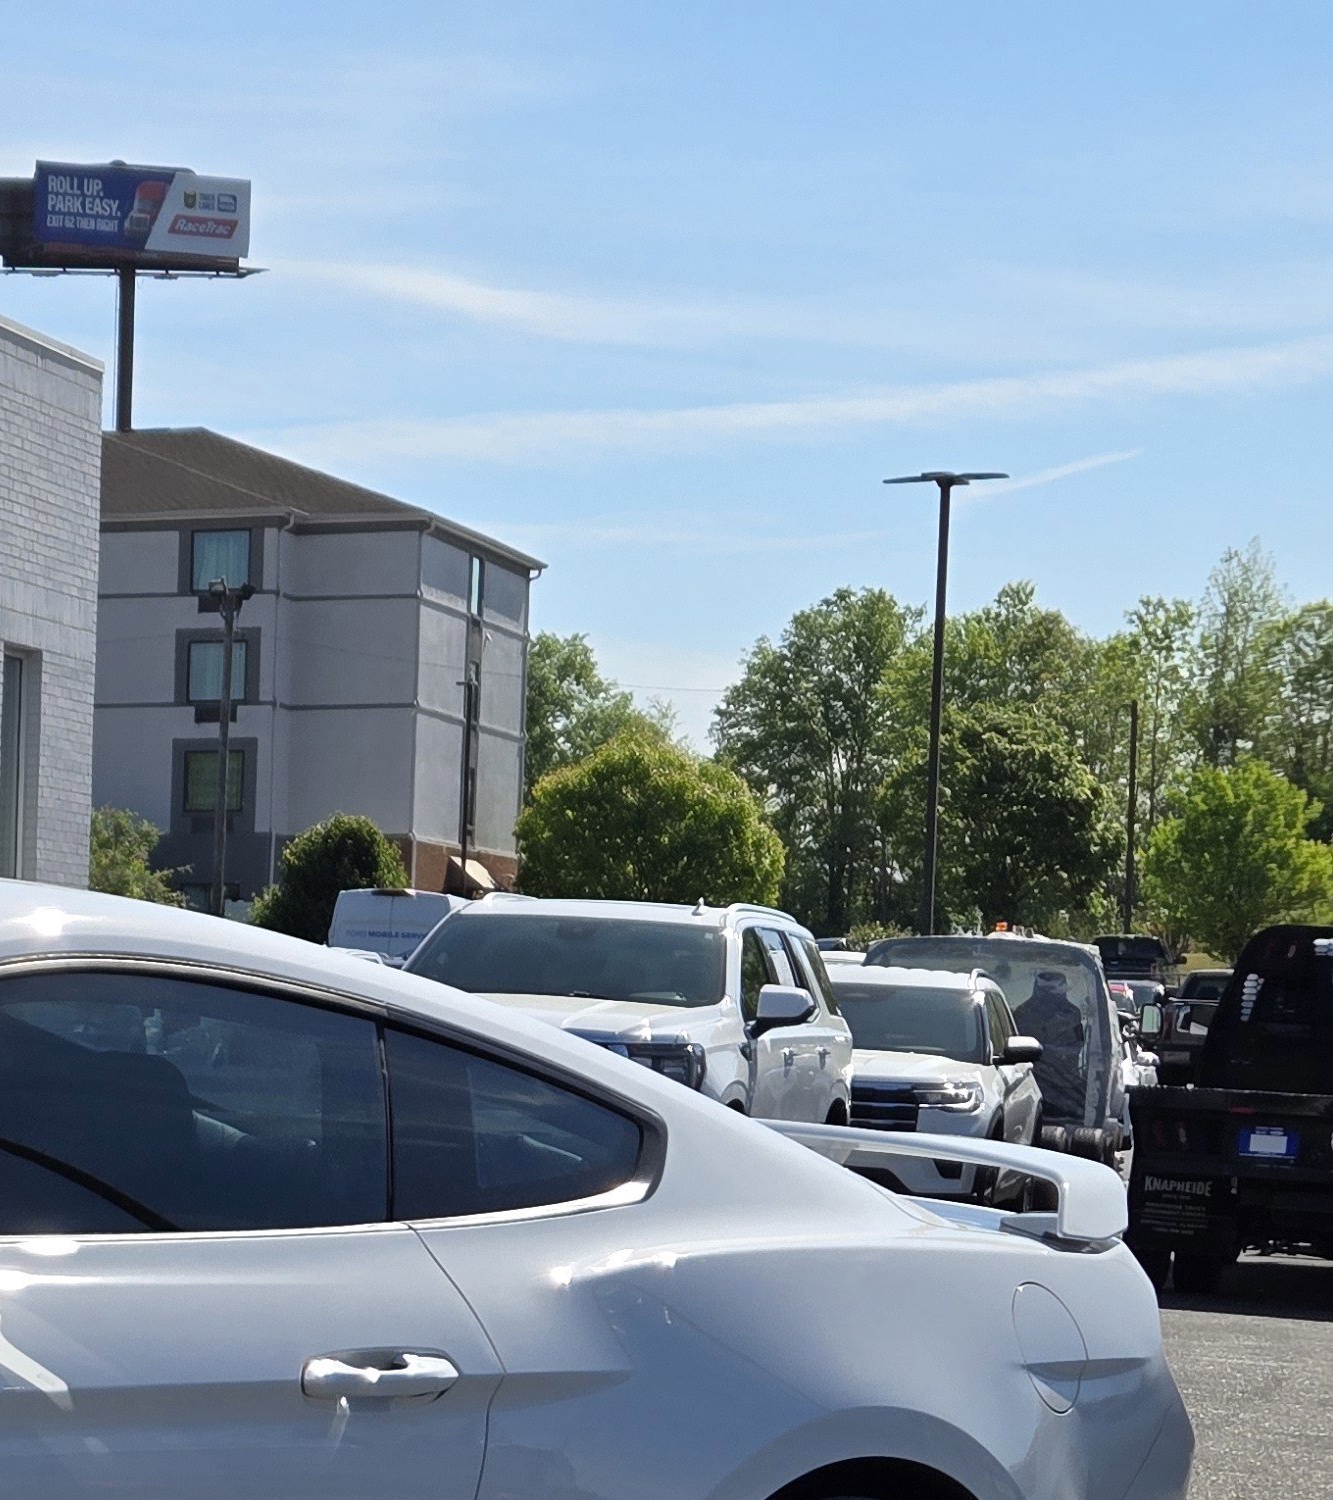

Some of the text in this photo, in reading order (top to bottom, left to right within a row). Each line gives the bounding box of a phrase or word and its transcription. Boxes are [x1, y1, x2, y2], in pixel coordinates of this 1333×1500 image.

[47, 174, 104, 197] ROLL UP.
[47, 194, 121, 217] PARK EASY.
[46, 214, 63, 228] EXIT
[76, 216, 95, 230] THEN
[96, 218, 119, 232] RIGHT
[174, 217, 231, 235] RaceTrac
[368, 930, 399, 939] MOBILE
[1144, 1175, 1213, 1197] KNAPHEIDE
